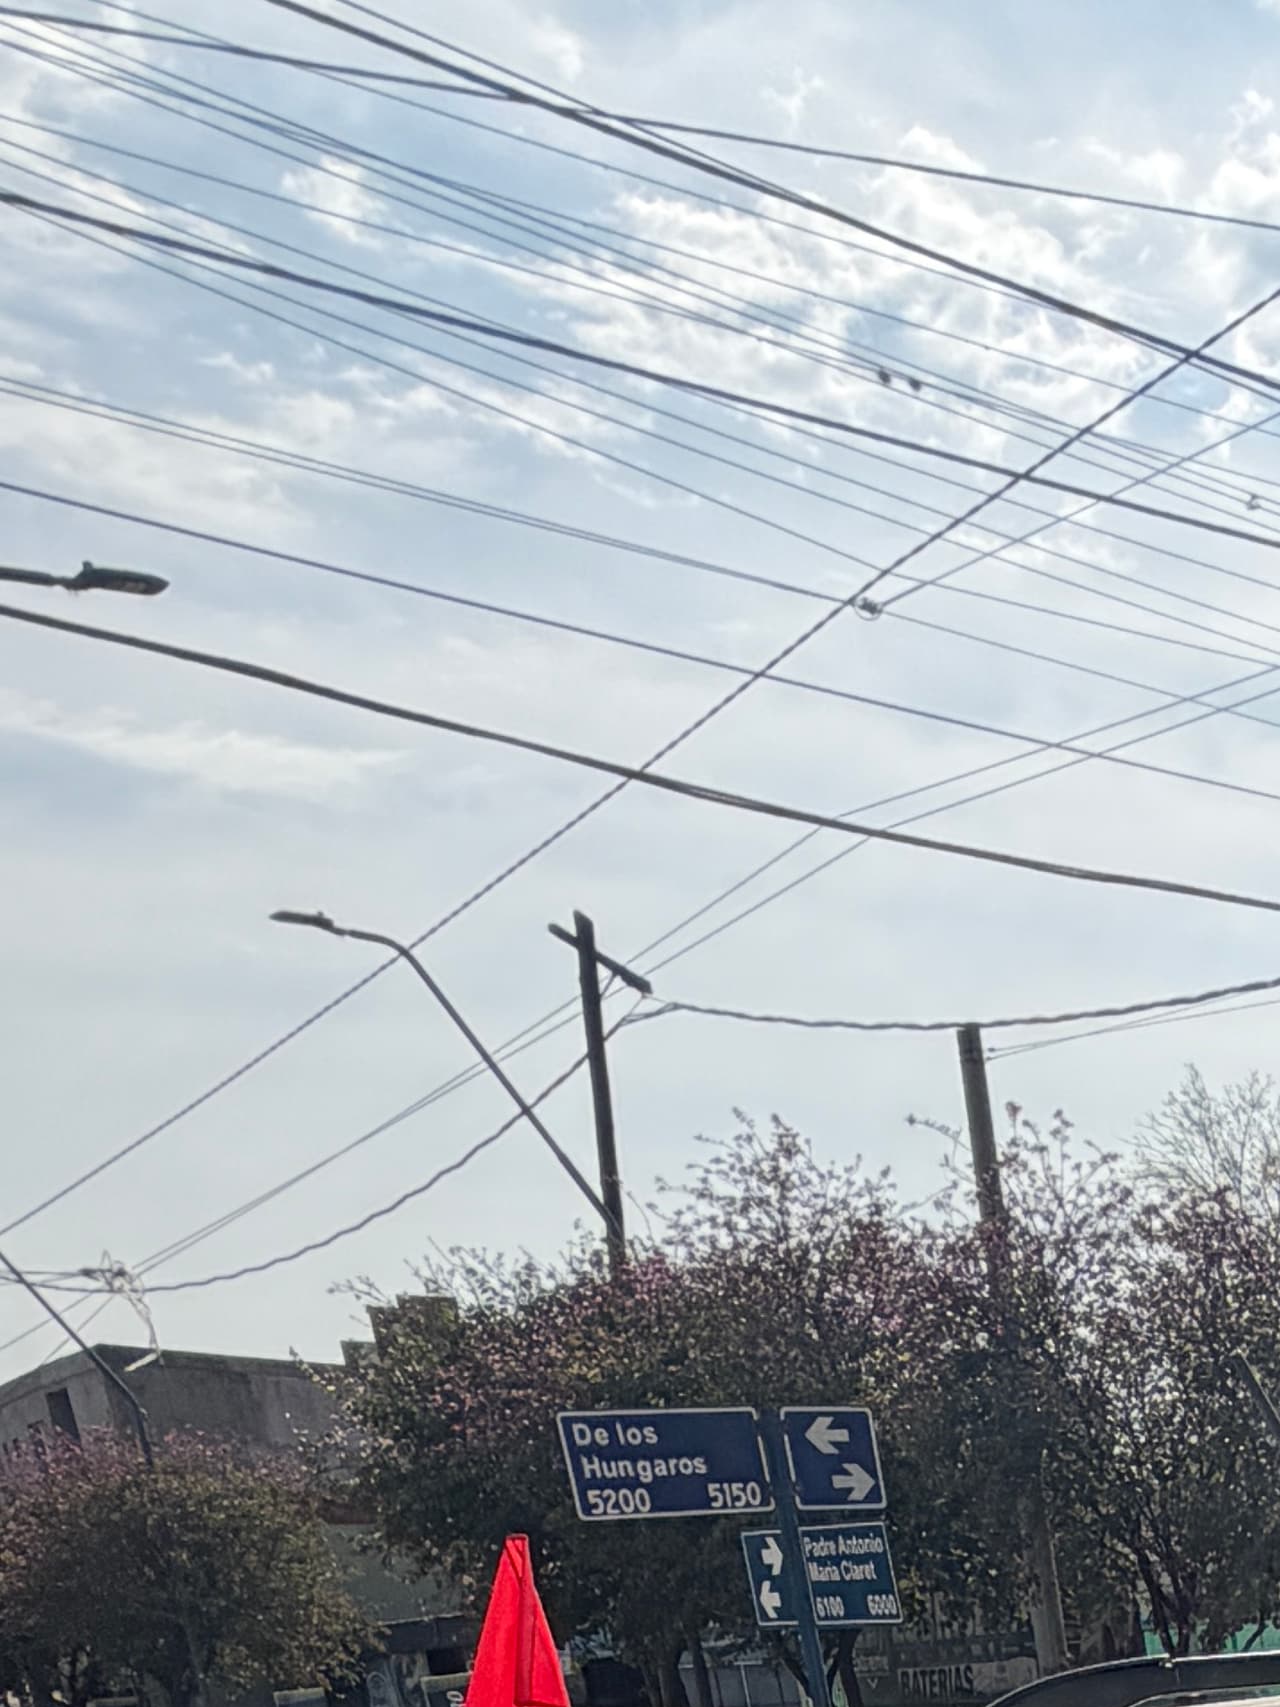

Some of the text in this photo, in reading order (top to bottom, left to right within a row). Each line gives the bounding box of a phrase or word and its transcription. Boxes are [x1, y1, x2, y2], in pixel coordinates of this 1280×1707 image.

[573, 1422, 658, 1446] De los
[582, 1456, 707, 1482] Hungaros
[587, 1489, 651, 1514] 5200
[707, 1481, 761, 1507] 5150
[803, 1536, 836, 1557] Padre
[900, 1664, 974, 1698] BATERIAS
